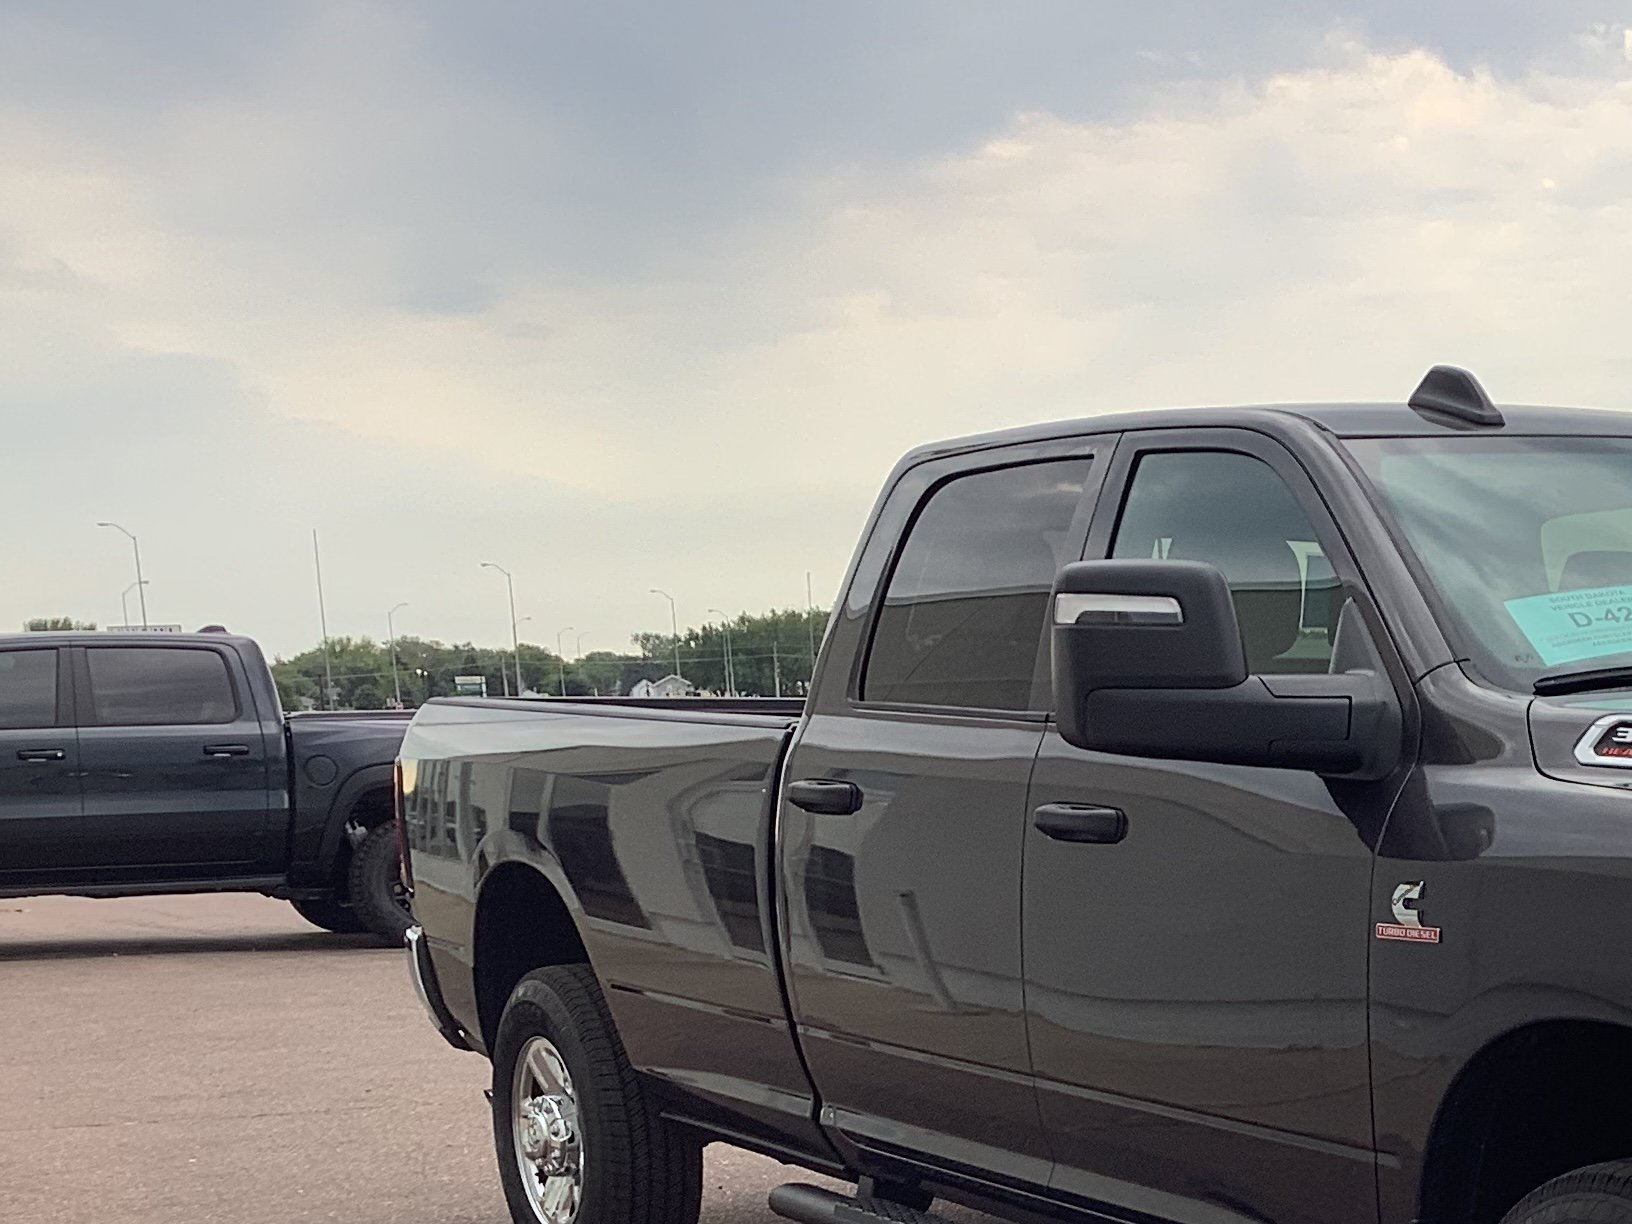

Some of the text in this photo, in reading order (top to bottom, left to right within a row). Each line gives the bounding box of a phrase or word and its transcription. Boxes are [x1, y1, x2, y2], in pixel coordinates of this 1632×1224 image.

[1550, 602, 1594, 611] VEHICLE
[1378, 926, 1437, 939] TURBO DIESEL
